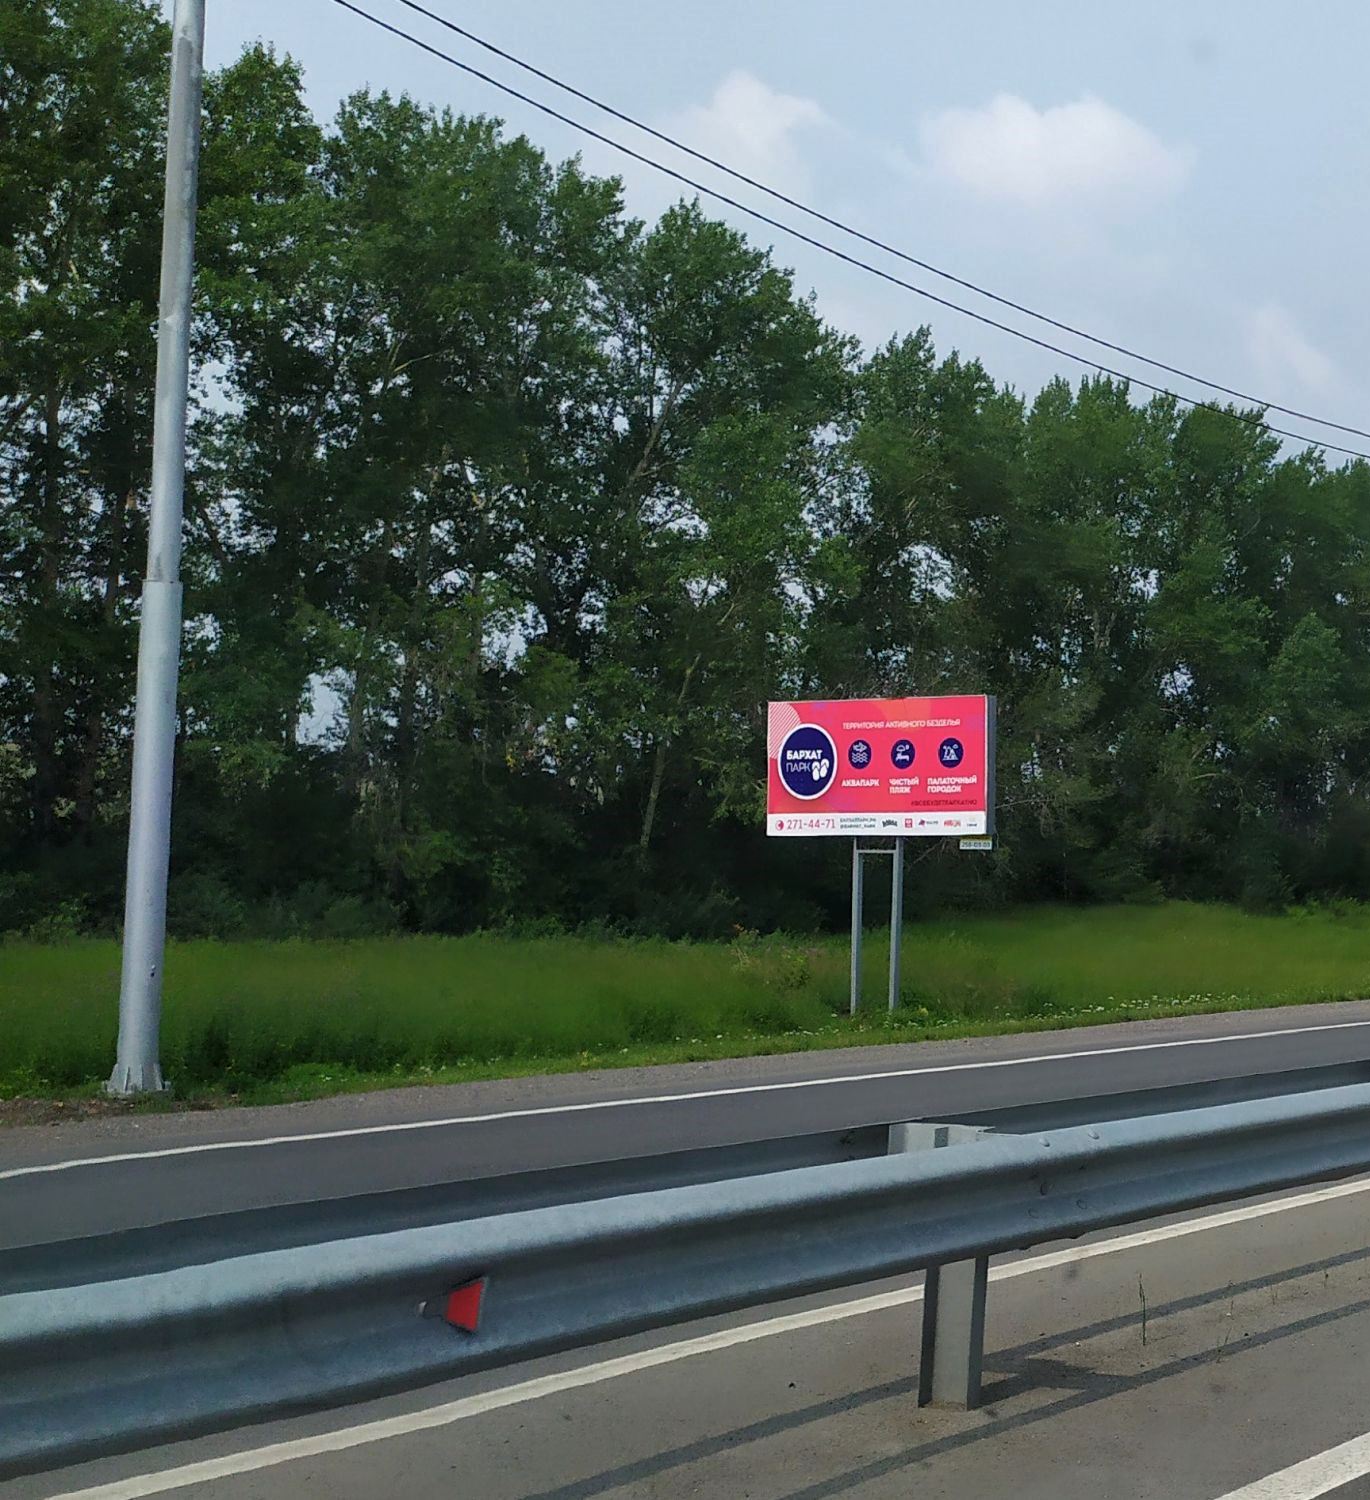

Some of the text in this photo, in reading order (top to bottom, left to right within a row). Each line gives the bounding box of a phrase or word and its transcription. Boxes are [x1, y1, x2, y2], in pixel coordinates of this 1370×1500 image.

[843, 719, 961, 730] ТЕРРИТОРИЯ АКТИВНОГО БЕЗДЕЛЬЯ
[786, 750, 823, 760] БАРХАТ
[786, 762, 811, 772] ПАРК
[841, 778, 880, 787] АКВАПАРК
[889, 776, 919, 786] ЧИСТЫЙ
[927, 775, 977, 785] ПАЛАТОЧНЫЙ
[889, 786, 912, 794] ПЛЯЖ
[927, 785, 962, 793] ГОРОДОК
[787, 819, 835, 830] 271-44-71
